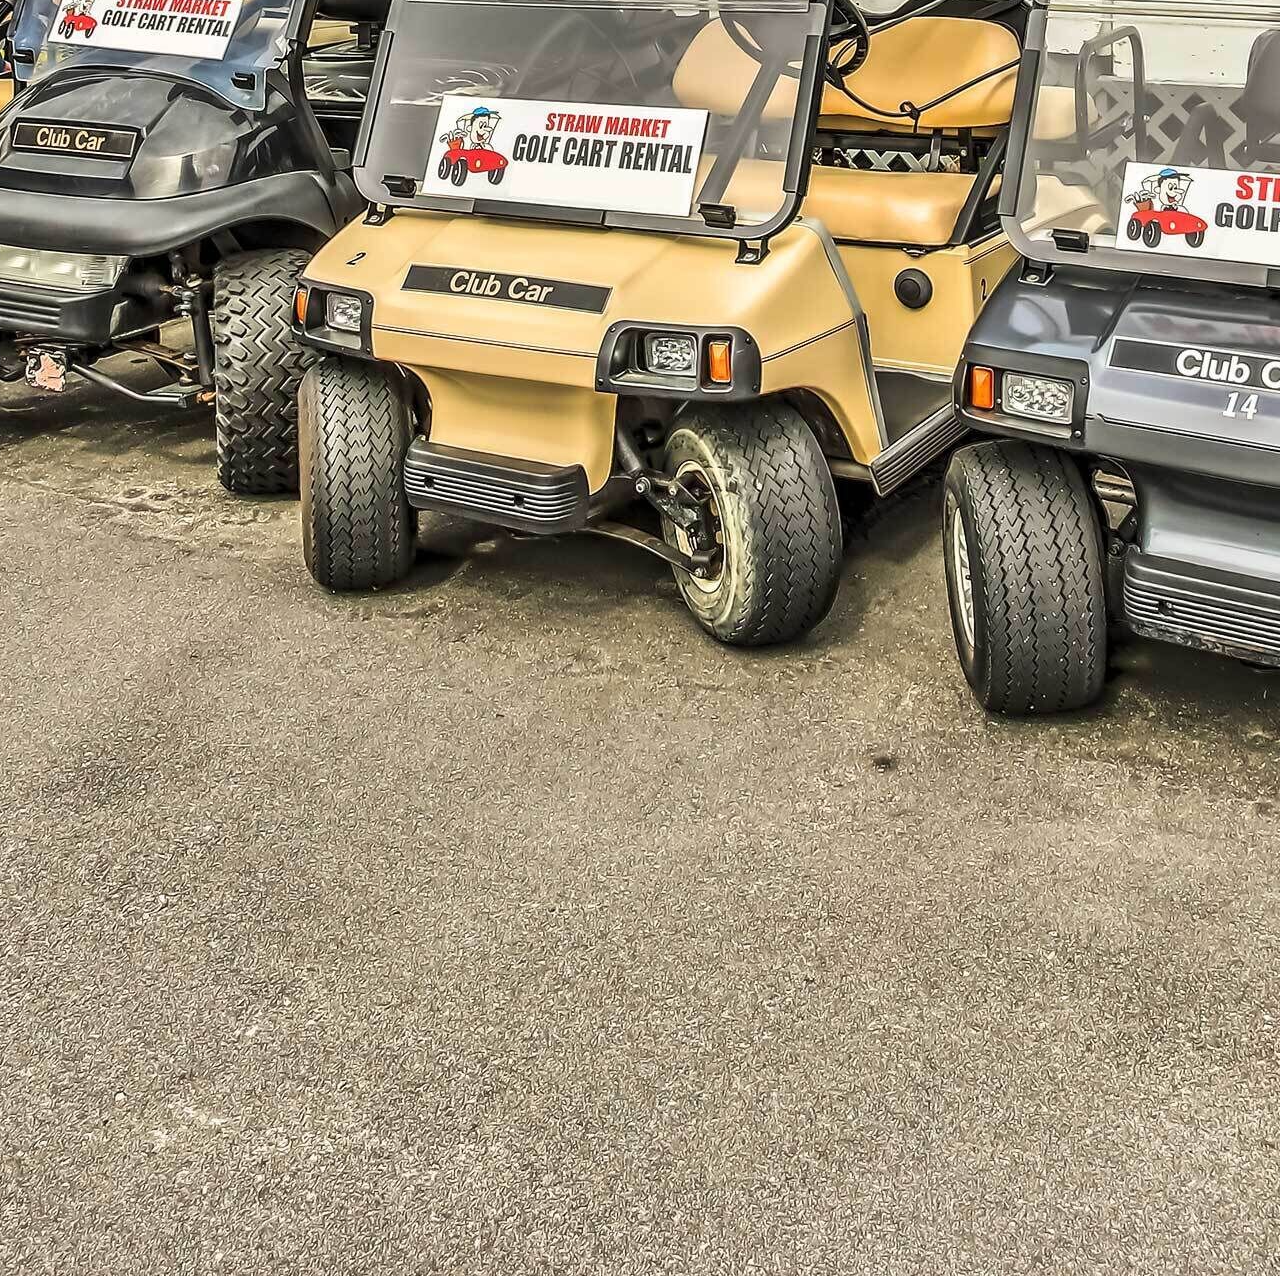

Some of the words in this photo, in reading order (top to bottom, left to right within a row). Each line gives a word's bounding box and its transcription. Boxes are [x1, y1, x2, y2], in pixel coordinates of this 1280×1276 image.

[101, 10, 137, 27] GOLF
[138, 13, 179, 32] CART
[175, 16, 232, 38] RENTAL
[36, 127, 70, 147] Club
[74, 130, 105, 150] Car
[545, 112, 605, 135] STRAW
[604, 116, 672, 139] MARKET
[512, 134, 563, 164] GOLF
[563, 136, 618, 169] CART
[618, 141, 693, 174] RENTAL
[346, 251, 367, 265] 2
[448, 271, 501, 297] Club
[507, 278, 554, 303] Car
[1175, 348, 1251, 384] Club
[1222, 391, 1259, 420] 14
